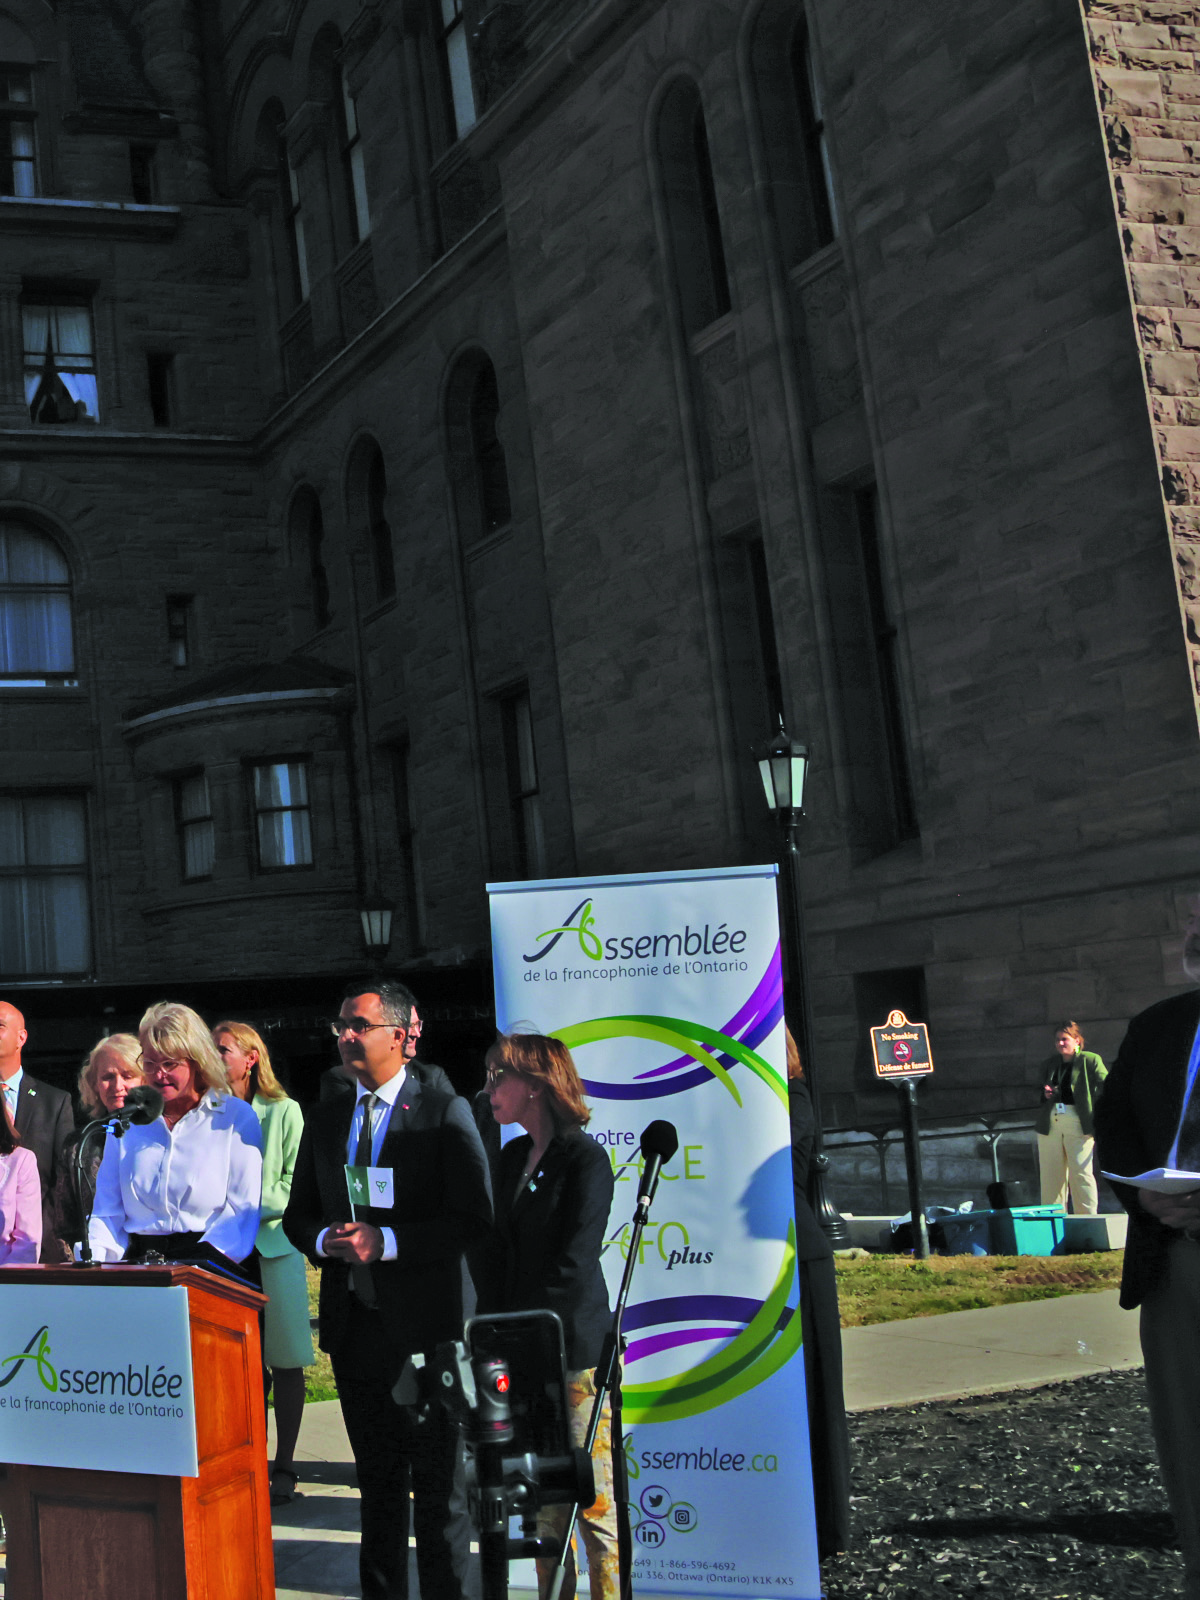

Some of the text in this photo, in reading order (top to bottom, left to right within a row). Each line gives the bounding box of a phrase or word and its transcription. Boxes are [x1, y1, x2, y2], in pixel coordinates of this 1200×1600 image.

[523, 897, 747, 963] Assemblée
[523, 969, 541, 982] de
[545, 968, 558, 981] la
[563, 963, 659, 982] francophonie
[663, 962, 680, 975] de
[881, 1032, 919, 1041] No Smoking
[903, 1062, 912, 1070] de
[912, 1061, 930, 1069] fumer
[665, 1246, 714, 1270] plus
[10, 1396, 21, 1409] la
[25, 1396, 105, 1415] francophonie
[109, 1401, 125, 1415] de
[660, 1559, 736, 1571] 1-866-596-4692
[668, 1571, 703, 1582] Ottawa
[706, 1572, 750, 1585] (Ontario)
[752, 1577, 772, 1585] K1K
[775, 1577, 794, 1586] 4X5
